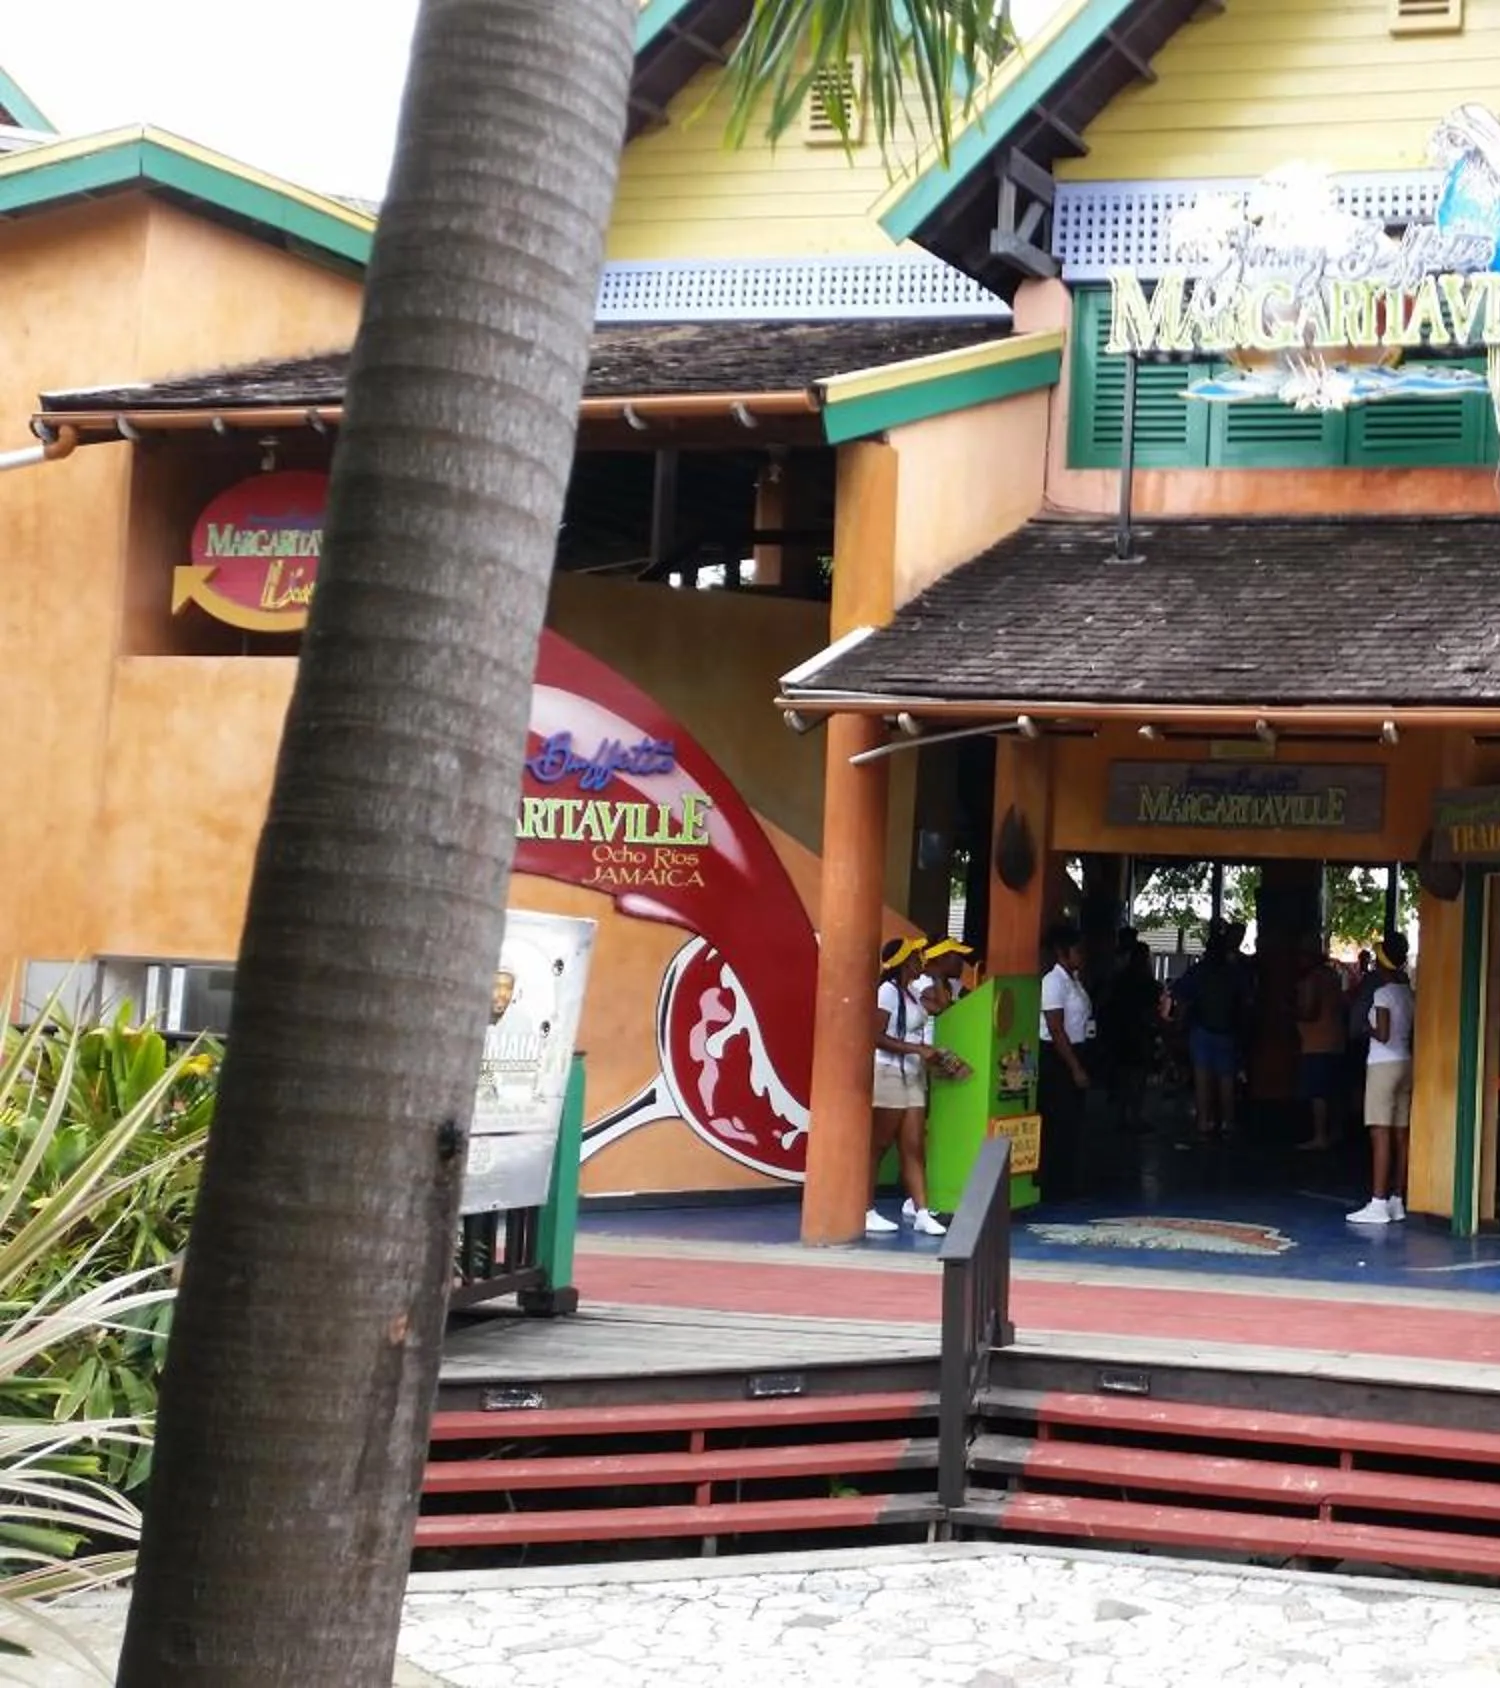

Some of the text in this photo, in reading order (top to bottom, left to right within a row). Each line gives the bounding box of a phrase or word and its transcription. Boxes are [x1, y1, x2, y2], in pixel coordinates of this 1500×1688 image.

[204, 523, 323, 557] MARGARITA
[515, 792, 712, 845] RITAVILLE
[1137, 785, 1347, 825] MARGARITAVILLE
[591, 845, 646, 864] Ocho
[582, 866, 705, 887] JAMAICA
